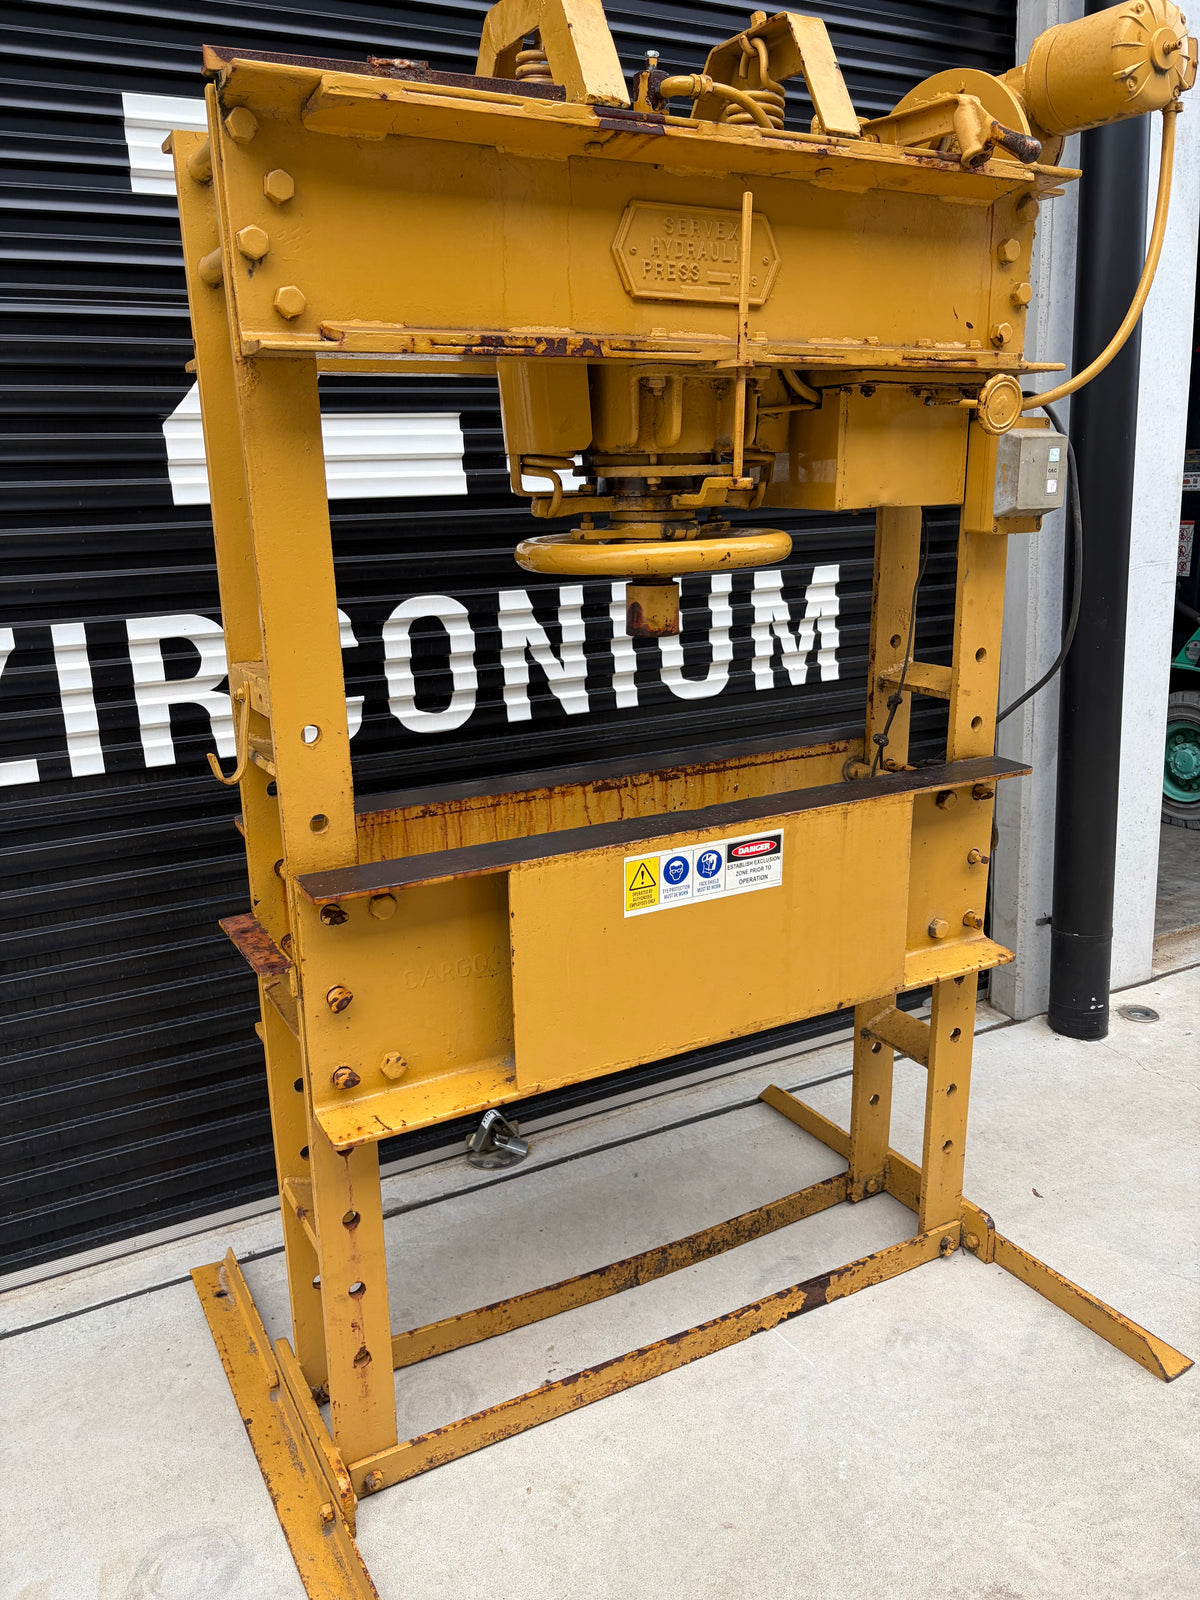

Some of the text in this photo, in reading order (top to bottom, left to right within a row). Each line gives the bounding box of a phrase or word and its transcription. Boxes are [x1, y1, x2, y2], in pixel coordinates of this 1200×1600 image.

[664, 216, 739, 242] SERVEX
[650, 237, 740, 264] HYDRAULI
[642, 258, 700, 282] PRESS
[0, 564, 840, 787] IRONIUM
[738, 842, 770, 855] DANGER
[727, 855, 780, 870] ESTABLISH EXCLUSION
[736, 869, 748, 877] ZONE
[750, 866, 764, 875] PRIOR
[738, 874, 768, 885] OPERATION
[669, 884, 690, 892] PROTECTION
